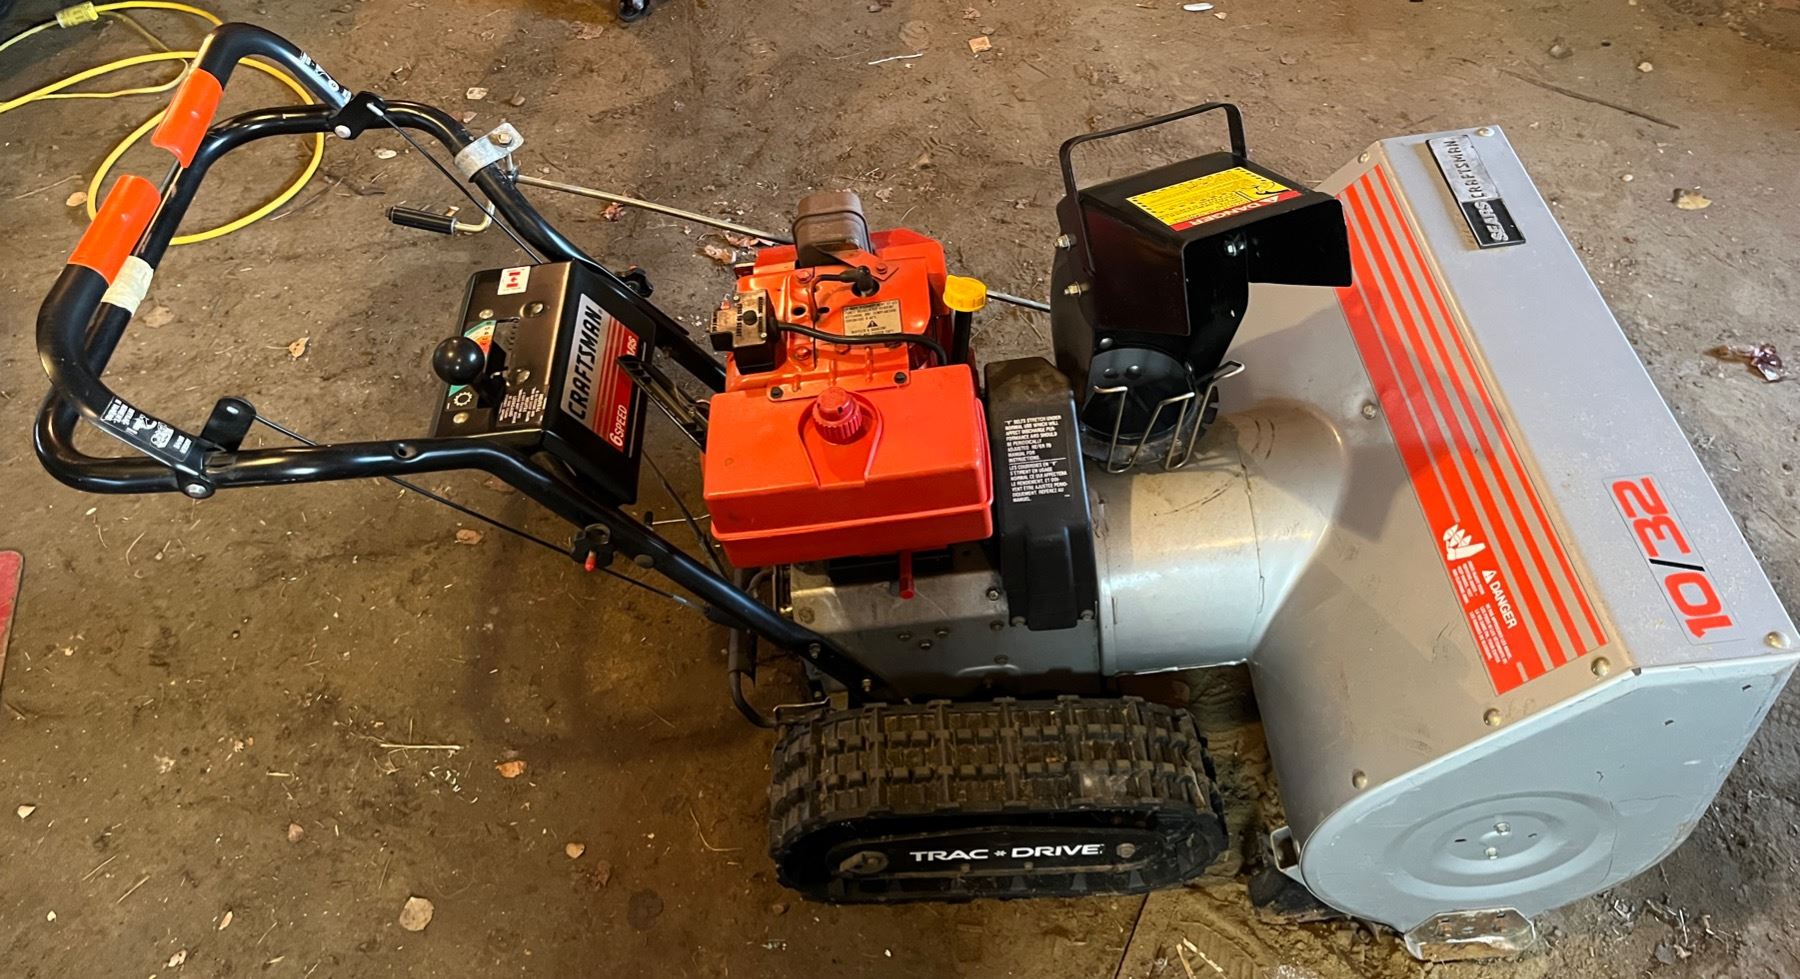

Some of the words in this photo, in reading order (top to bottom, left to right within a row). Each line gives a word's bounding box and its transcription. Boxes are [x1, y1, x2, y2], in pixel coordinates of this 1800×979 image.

[1443, 140, 1484, 198] CRAFTSMAN
[1189, 202, 1262, 226] DANGER
[1474, 200, 1508, 241] SEARS
[568, 305, 602, 420] CRAFTSMAN
[1612, 476, 1734, 639] 10/32
[1489, 582, 1518, 628] DANGER
[910, 850, 988, 861] TRAC
[1012, 844, 1100, 858] DRIVE
